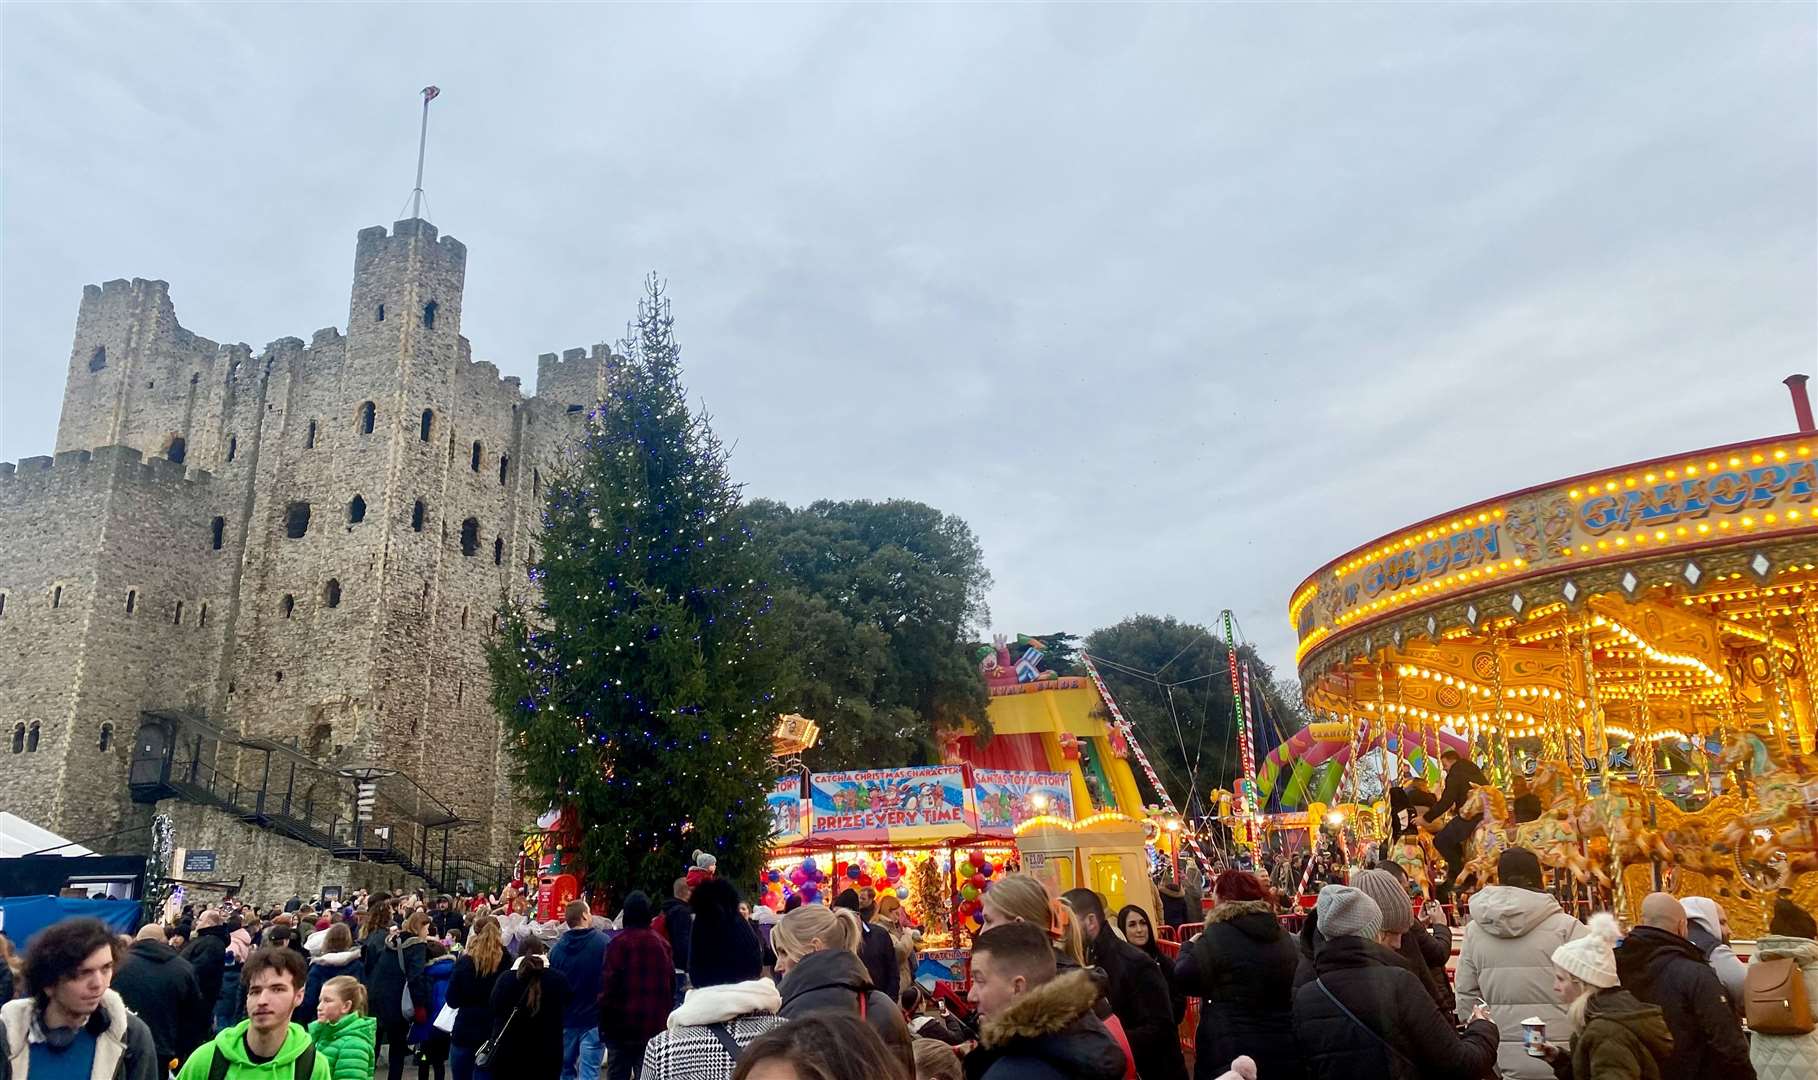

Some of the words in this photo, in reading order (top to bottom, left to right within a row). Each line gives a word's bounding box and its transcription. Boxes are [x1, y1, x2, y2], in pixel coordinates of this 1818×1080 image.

[1362, 523, 1501, 598] GOLDEN
[814, 774, 846, 784] CATCH
[854, 770, 905, 781] CHRISTMAS
[906, 765, 961, 778] CHARACTER
[1011, 773, 1026, 785] TOY
[1028, 774, 1066, 787] FACTORY
[776, 779, 798, 792] TORY
[816, 813, 863, 831] PRIZE
[864, 810, 918, 827] EVERY
[921, 807, 962, 823] TIME
